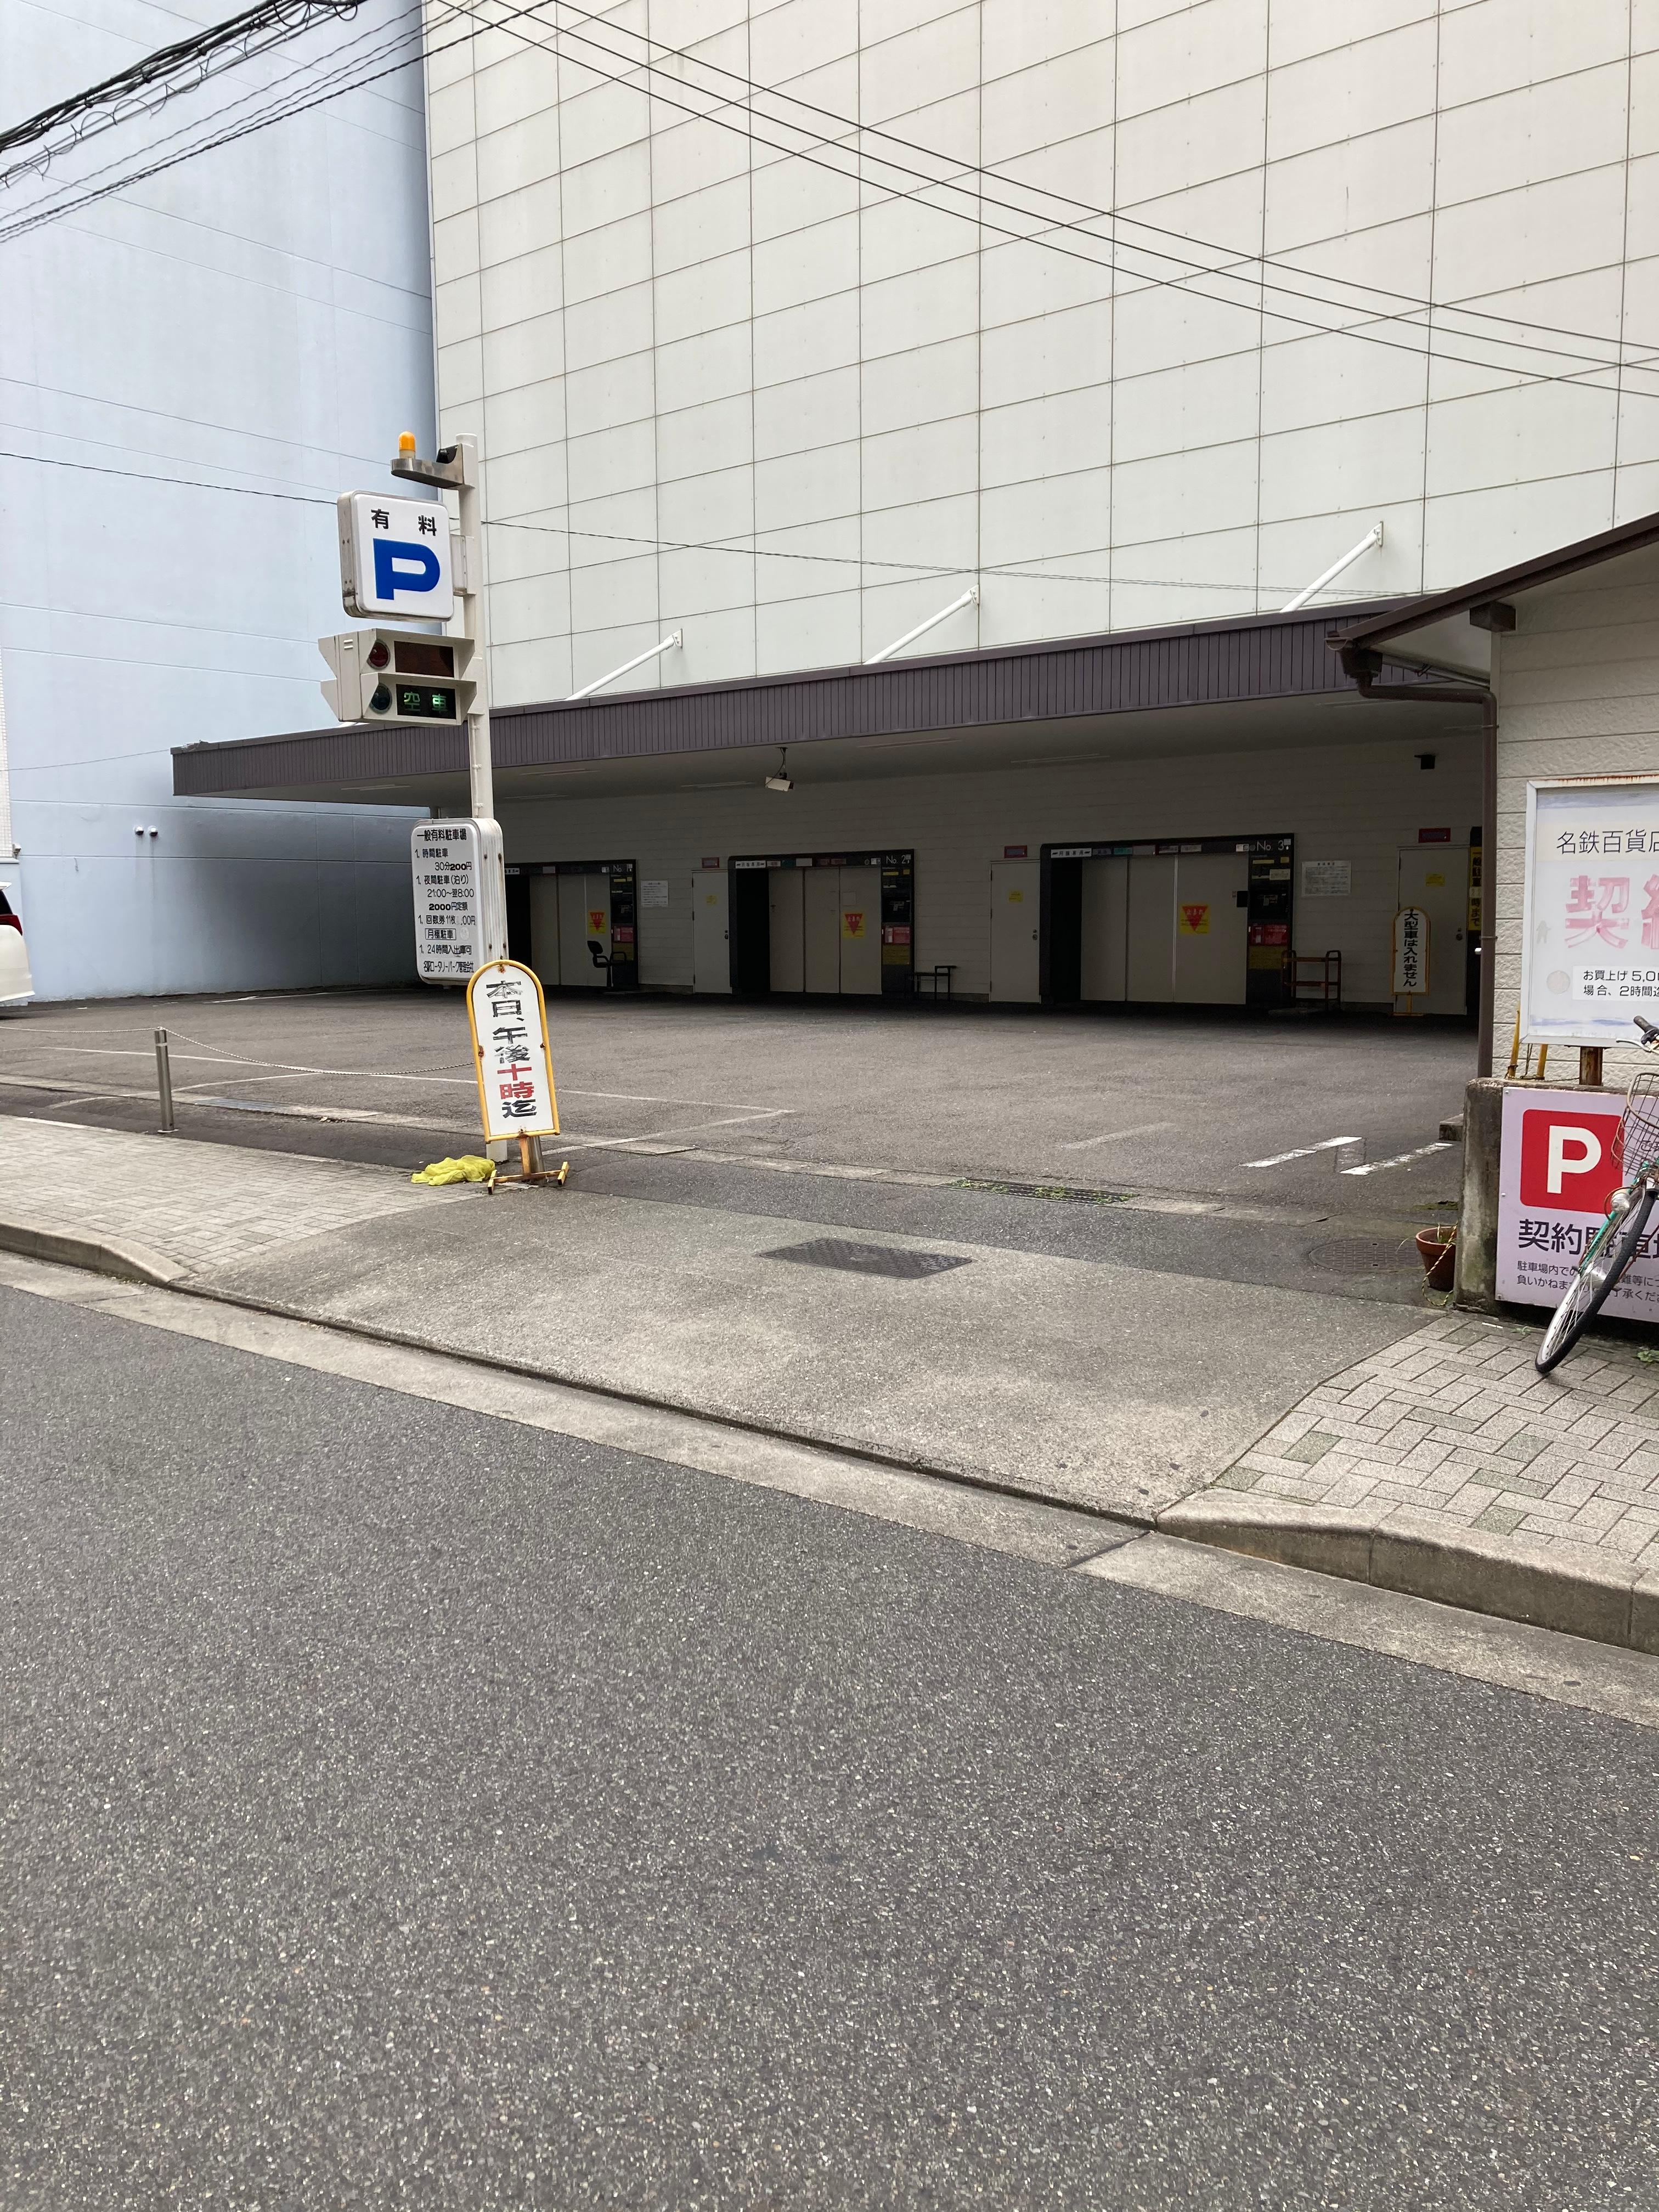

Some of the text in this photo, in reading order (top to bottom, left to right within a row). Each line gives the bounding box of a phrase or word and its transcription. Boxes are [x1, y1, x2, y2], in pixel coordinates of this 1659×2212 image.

[371, 509, 437, 536] 有料
[373, 538, 441, 601] P
[404, 691, 449, 713] 空車
[417, 828, 467, 842] 一般有料駐車場
[422, 848, 449, 859] 時間駐車
[435, 862, 472, 871] 30分200円
[427, 929, 454, 940] 月極駐車
[427, 944, 472, 955] 24時間入出庫可
[1403, 912, 1419, 987] 大型車は入れません
[1632, 970, 1659, 983] 5,0
[1546, 1125, 1602, 1194] P
